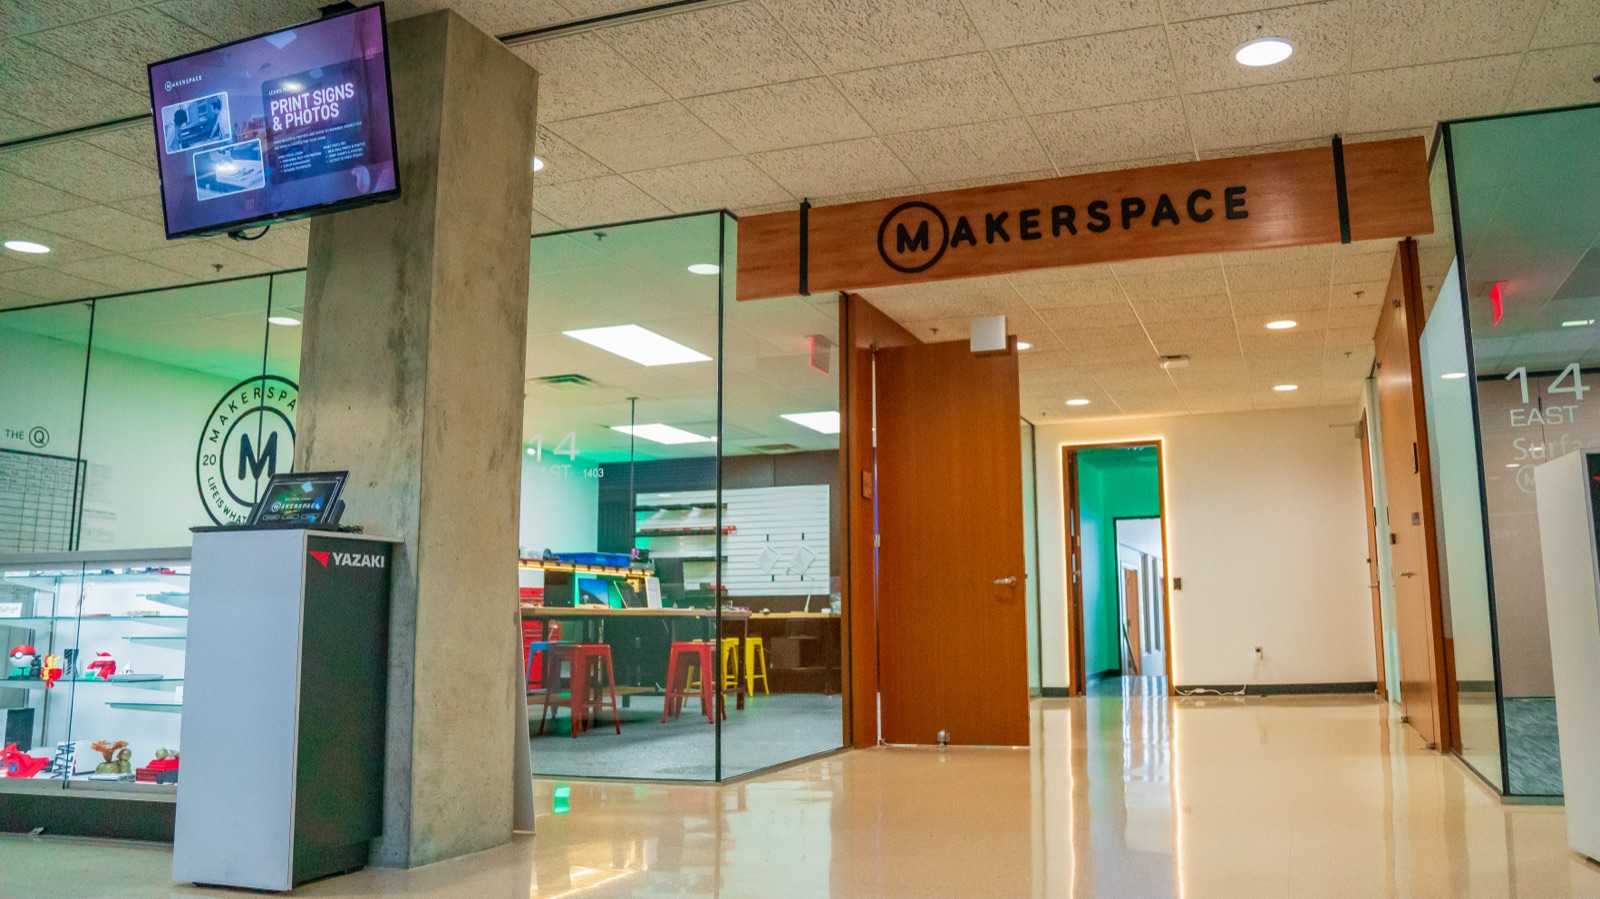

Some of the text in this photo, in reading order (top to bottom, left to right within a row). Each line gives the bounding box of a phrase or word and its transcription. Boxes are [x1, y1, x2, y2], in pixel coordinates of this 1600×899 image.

[165, 75, 202, 91] MAKERSPACE
[270, 92, 310, 116] PRINT
[312, 82, 354, 106] SIGNS
[272, 102, 339, 131] & PHOTOS
[878, 186, 1249, 273] MAKERSPACE
[1505, 362, 1591, 404] 14
[209, 387, 297, 443] MAKERSPA
[1510, 405, 1579, 427] EAST
[5, 429, 25, 440] THE
[528, 431, 580, 463] 14
[203, 454, 217, 466] 20
[238, 431, 278, 480] M
[583, 467, 604, 478] 1403
[207, 476, 219, 499] LIFE
[223, 505, 246, 523] WHAT
[332, 551, 385, 568] YAZAKI
[51, 742, 76, 779] YAZAK
